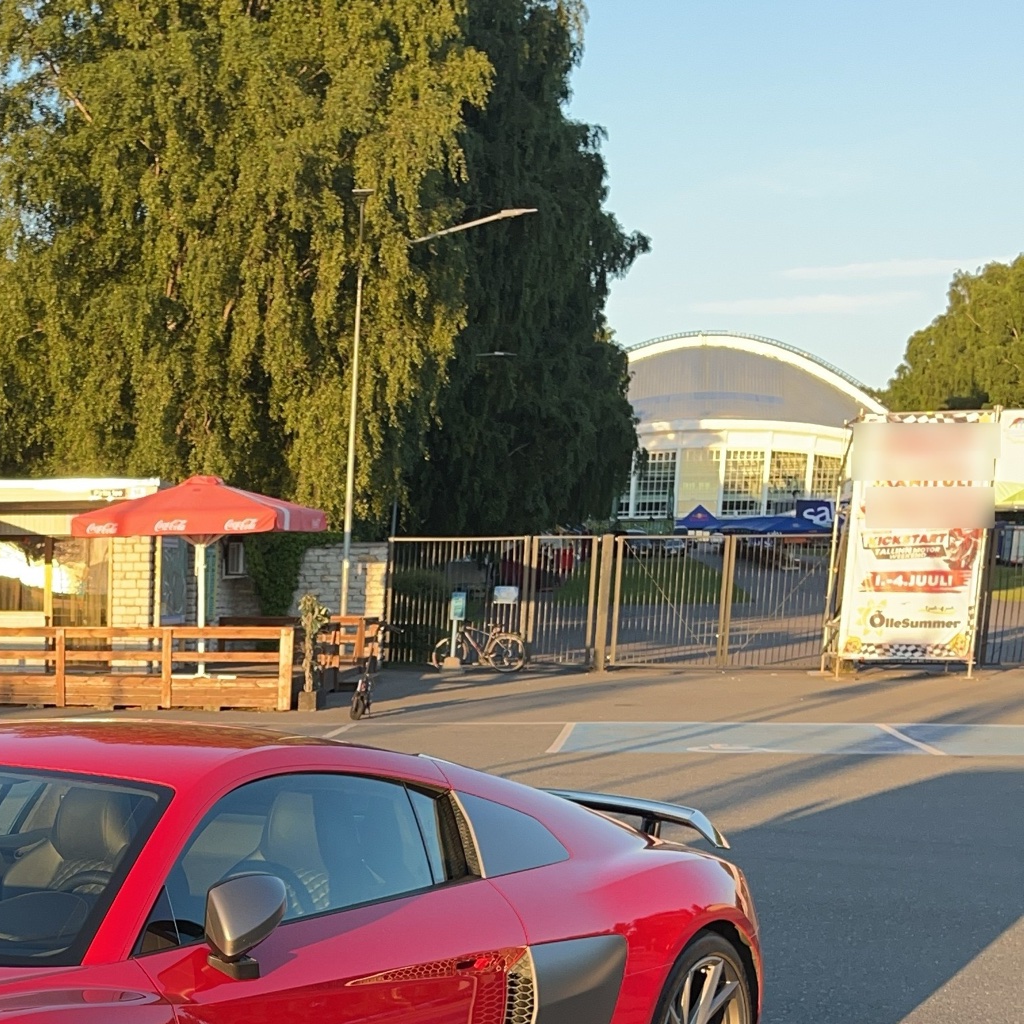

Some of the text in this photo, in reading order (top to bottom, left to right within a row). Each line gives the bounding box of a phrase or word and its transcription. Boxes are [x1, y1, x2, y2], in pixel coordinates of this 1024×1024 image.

[86, 523, 118, 534] Coca-Cola
[154, 519, 188, 532] Coca-Cola
[224, 518, 258, 531] Coca-Cola
[869, 610, 961, 628] ÕlleSummer
